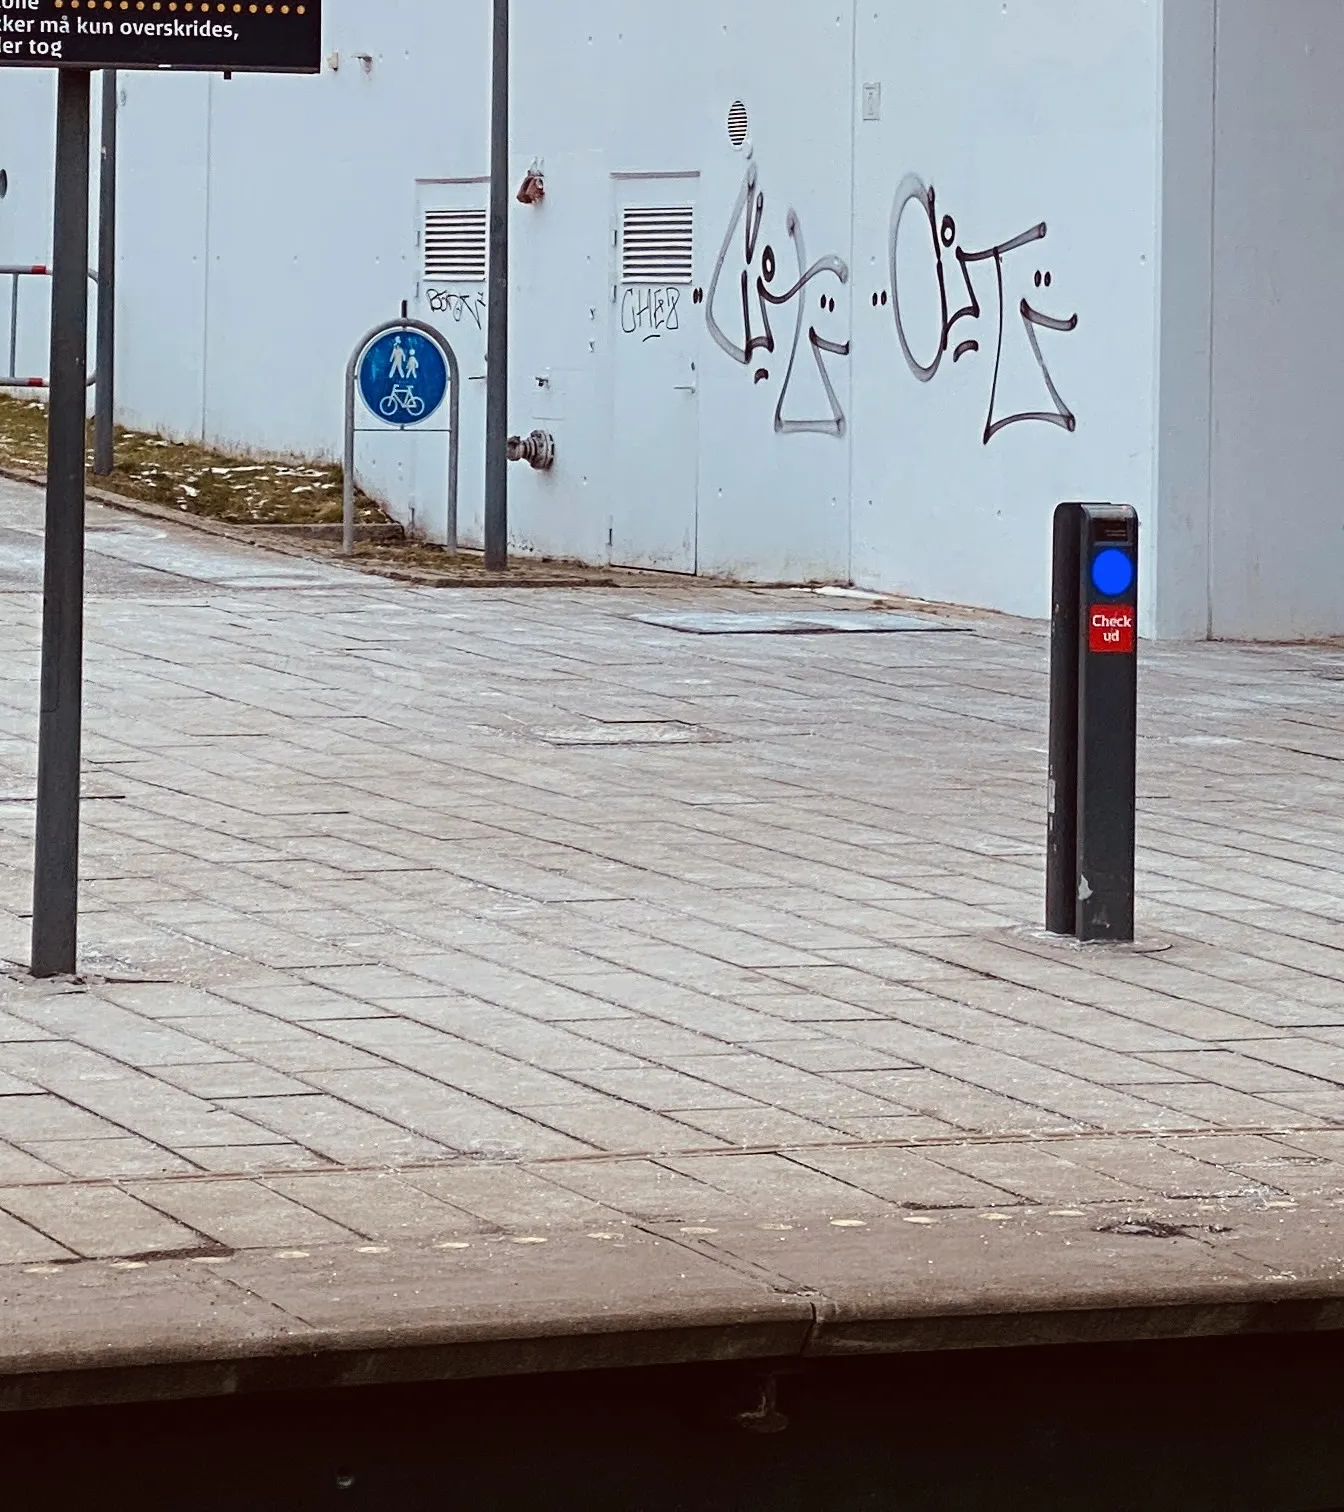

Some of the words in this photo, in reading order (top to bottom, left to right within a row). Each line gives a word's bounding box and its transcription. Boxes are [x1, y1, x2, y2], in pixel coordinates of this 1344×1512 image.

[40, 15, 70, 33] må
[77, 17, 114, 35] kun
[120, 19, 240, 40] overskrides,
[29, 40, 62, 59] tog
[1092, 614, 1132, 629] Check
[1103, 629, 1120, 643] ud
